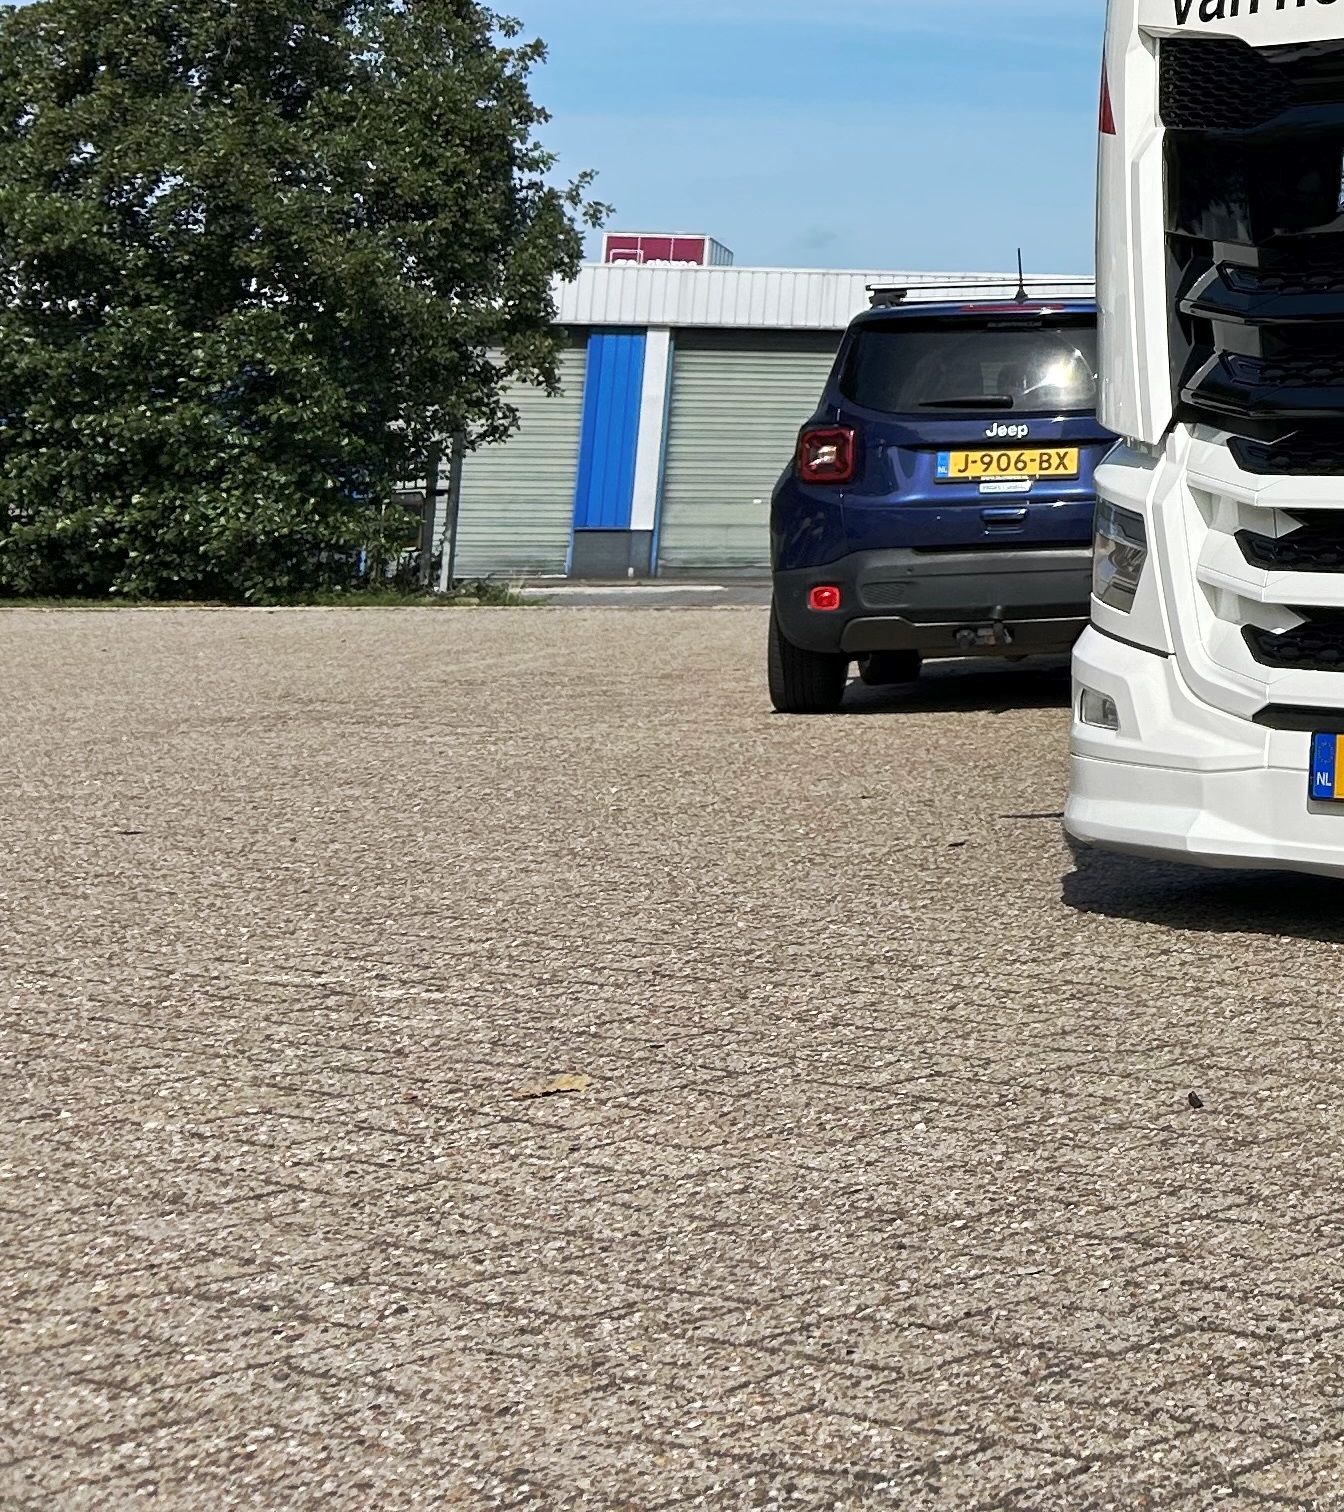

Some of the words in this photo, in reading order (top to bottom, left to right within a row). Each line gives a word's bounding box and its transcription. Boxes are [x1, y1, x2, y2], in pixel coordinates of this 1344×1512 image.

[985, 422, 1029, 438] Jeep
[957, 451, 1069, 474] J-906-BX
[1316, 771, 1332, 788] NL
